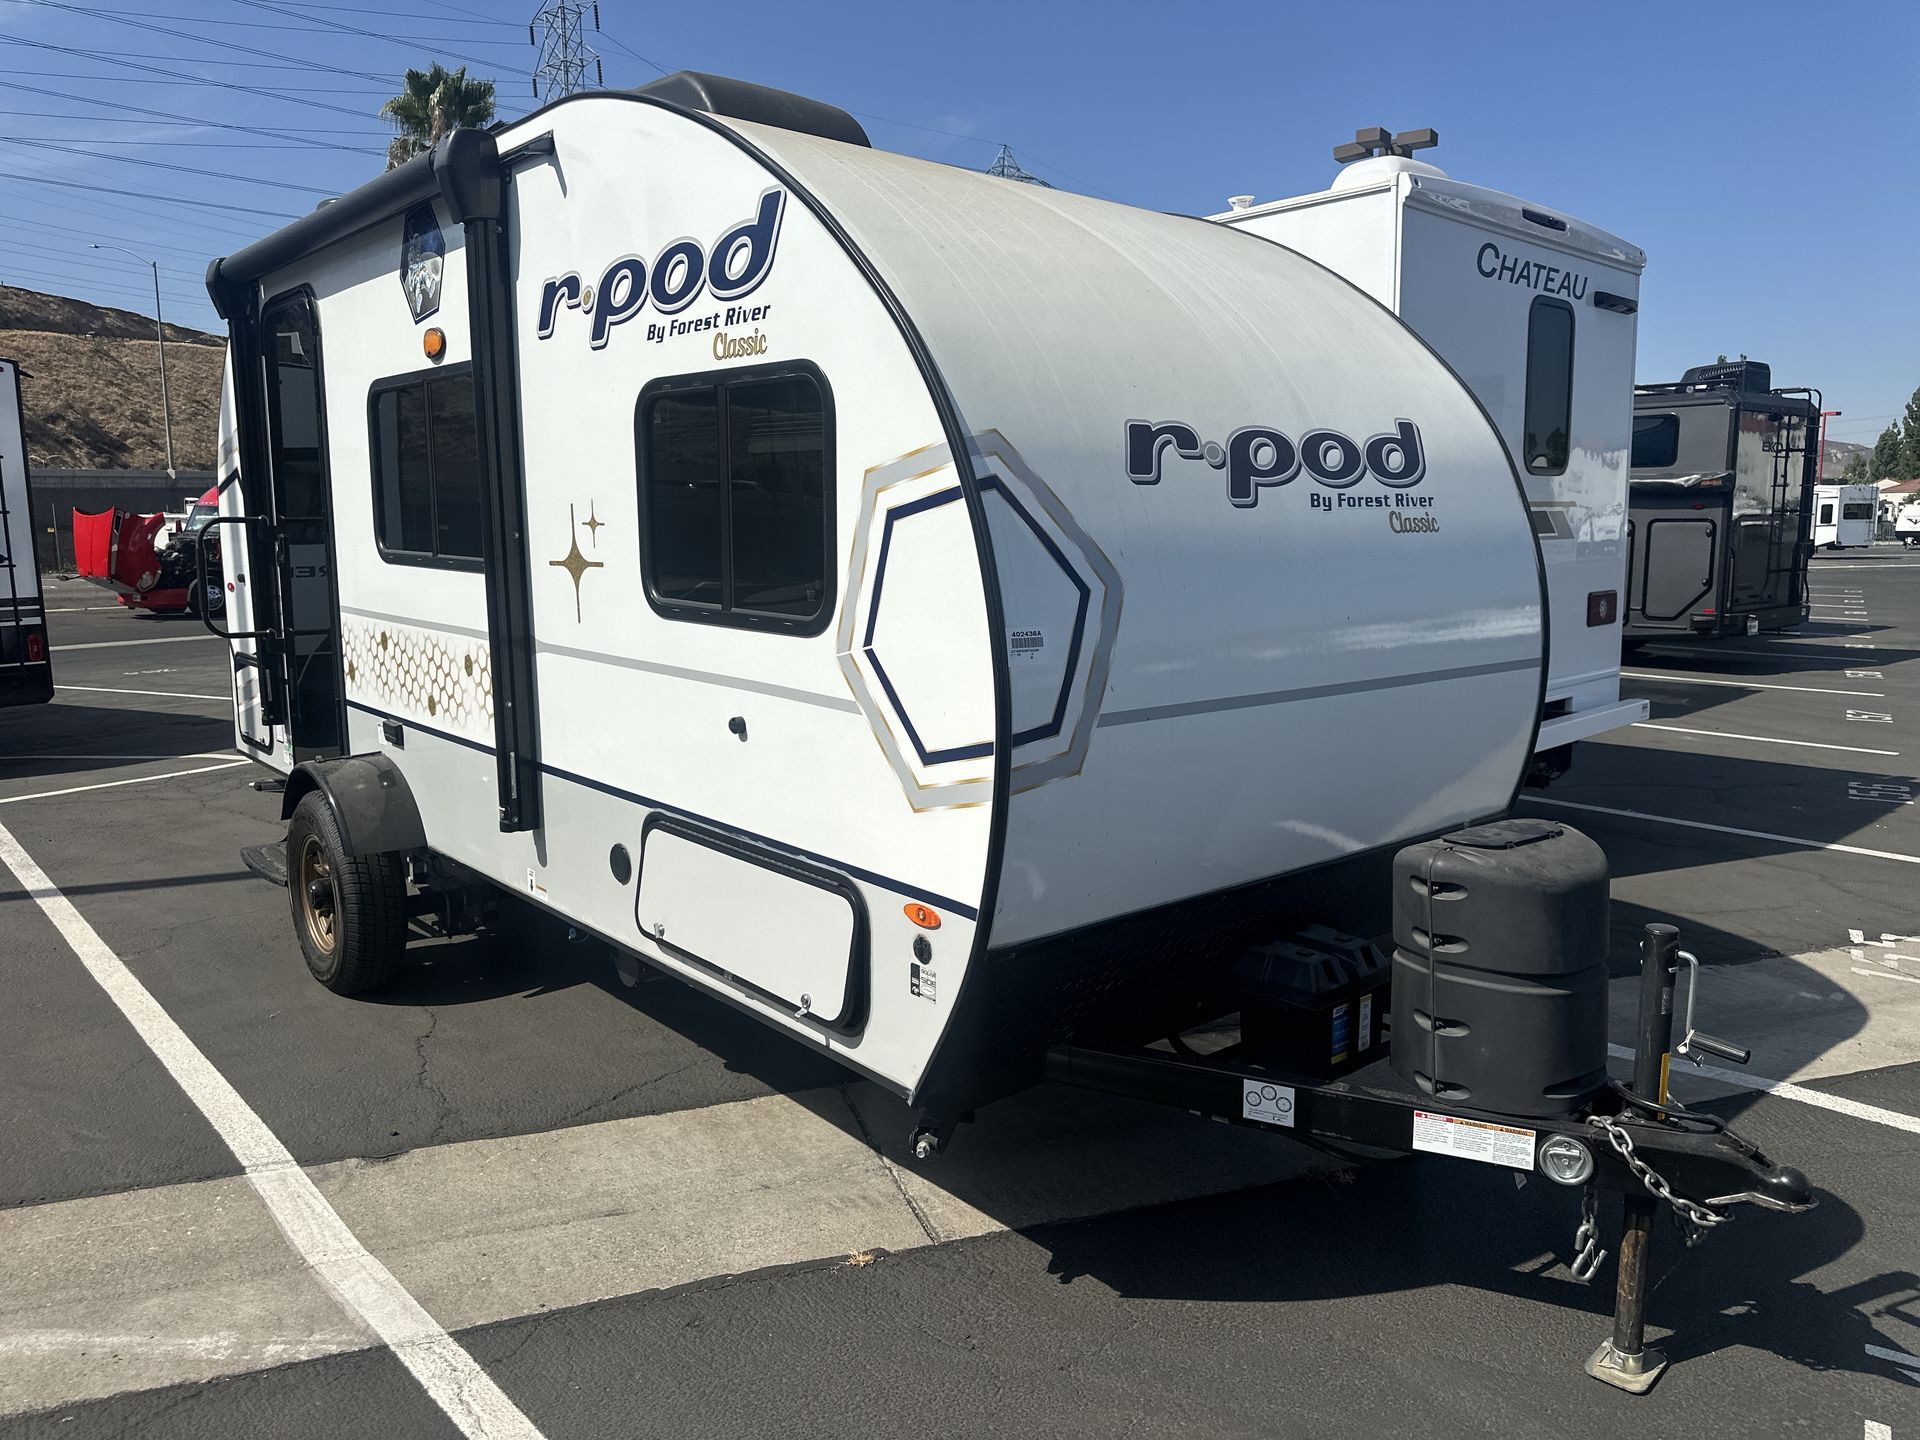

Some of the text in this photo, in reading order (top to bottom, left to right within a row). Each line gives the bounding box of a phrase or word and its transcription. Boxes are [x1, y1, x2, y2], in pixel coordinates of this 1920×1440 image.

[1476, 242, 1588, 301] CHATEAU
[646, 304, 771, 343] By Forest River
[712, 328, 768, 361] Classic
[1309, 492, 1434, 511] By Forest River
[1389, 511, 1440, 534] Classic
[1848, 781, 1914, 805] 156
[1464, 1121, 1488, 1129] WARNING
